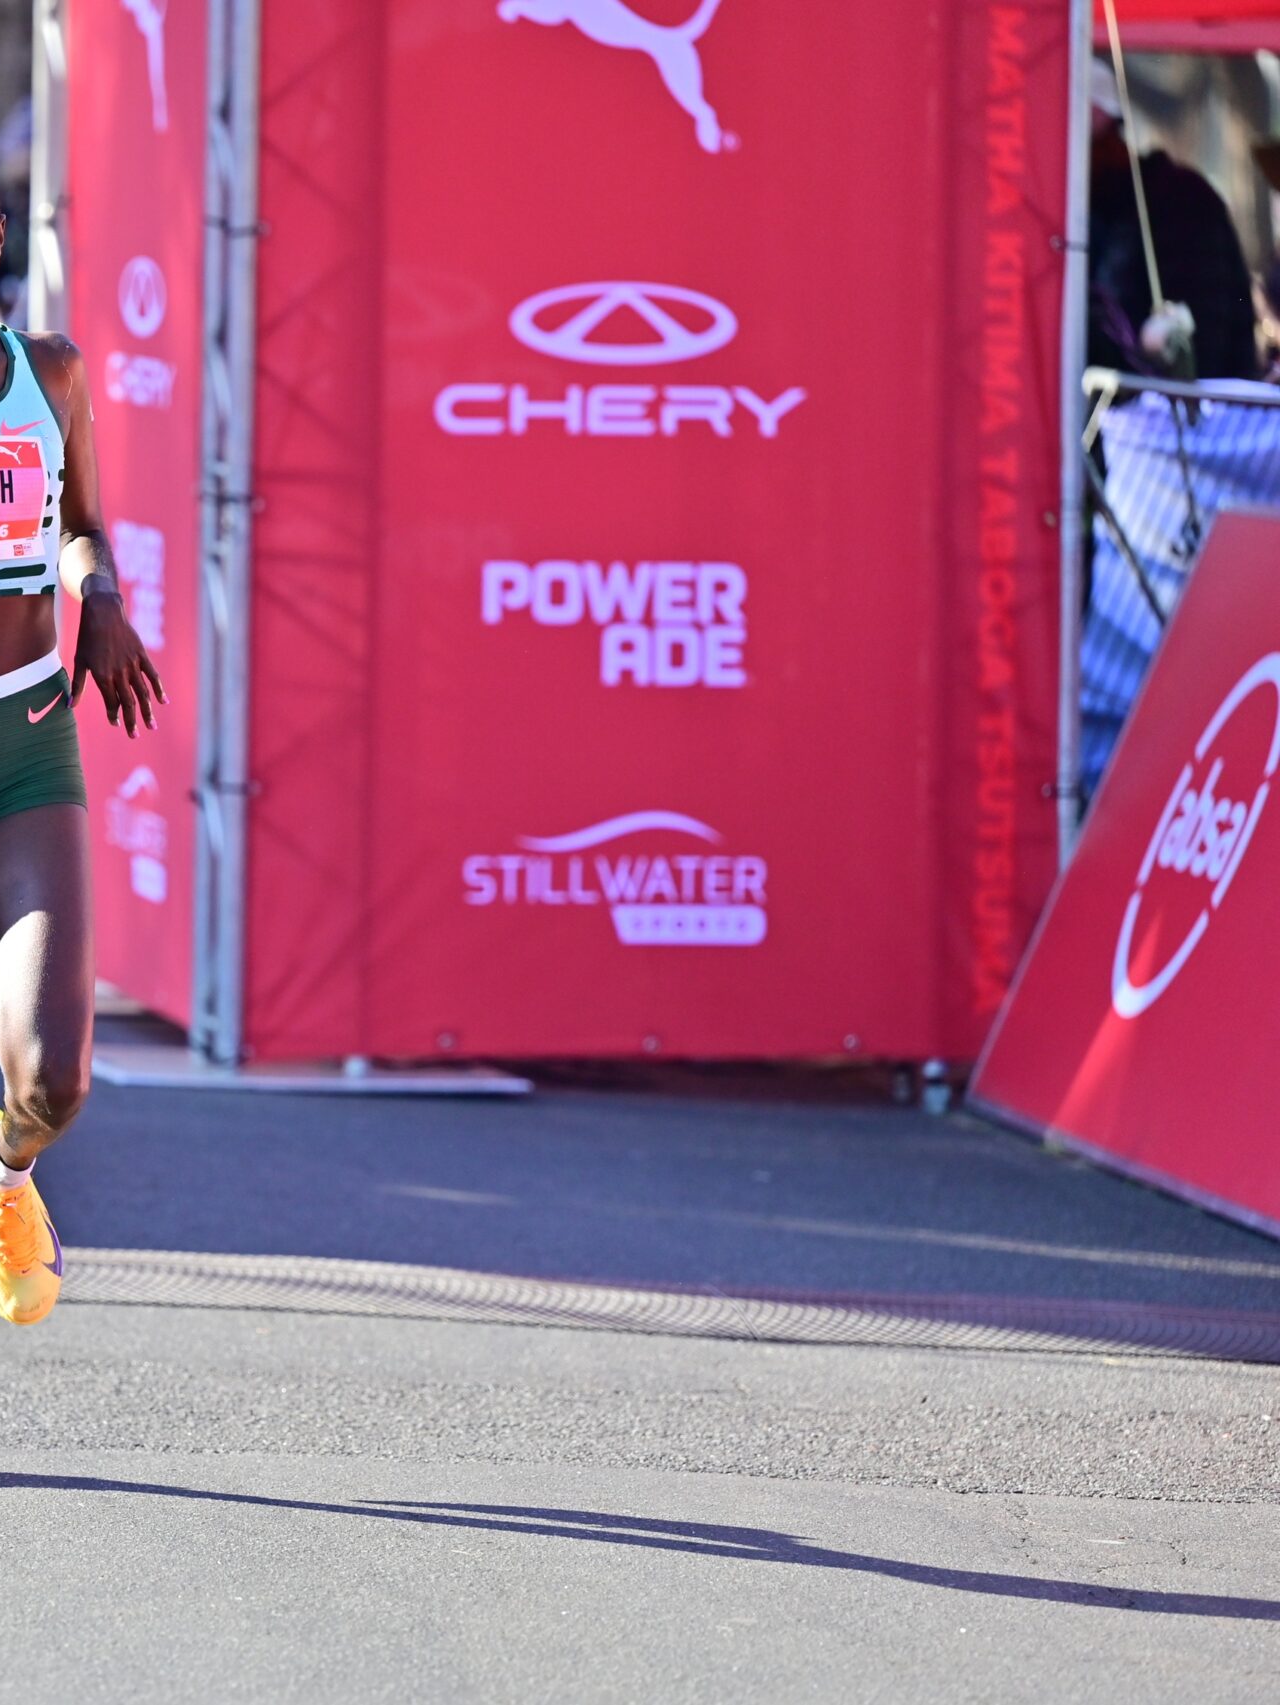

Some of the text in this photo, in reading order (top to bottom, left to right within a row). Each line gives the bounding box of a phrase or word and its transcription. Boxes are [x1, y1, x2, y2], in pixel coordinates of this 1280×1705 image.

[433, 382, 807, 439] CHERY
[972, 4, 1026, 1014] MATHA KITIMA TABOGA TSUTSUMA
[481, 559, 748, 626] POWER
[600, 623, 749, 688] ADE
[1157, 756, 1249, 881] absa
[462, 854, 768, 905] STILLWATER
